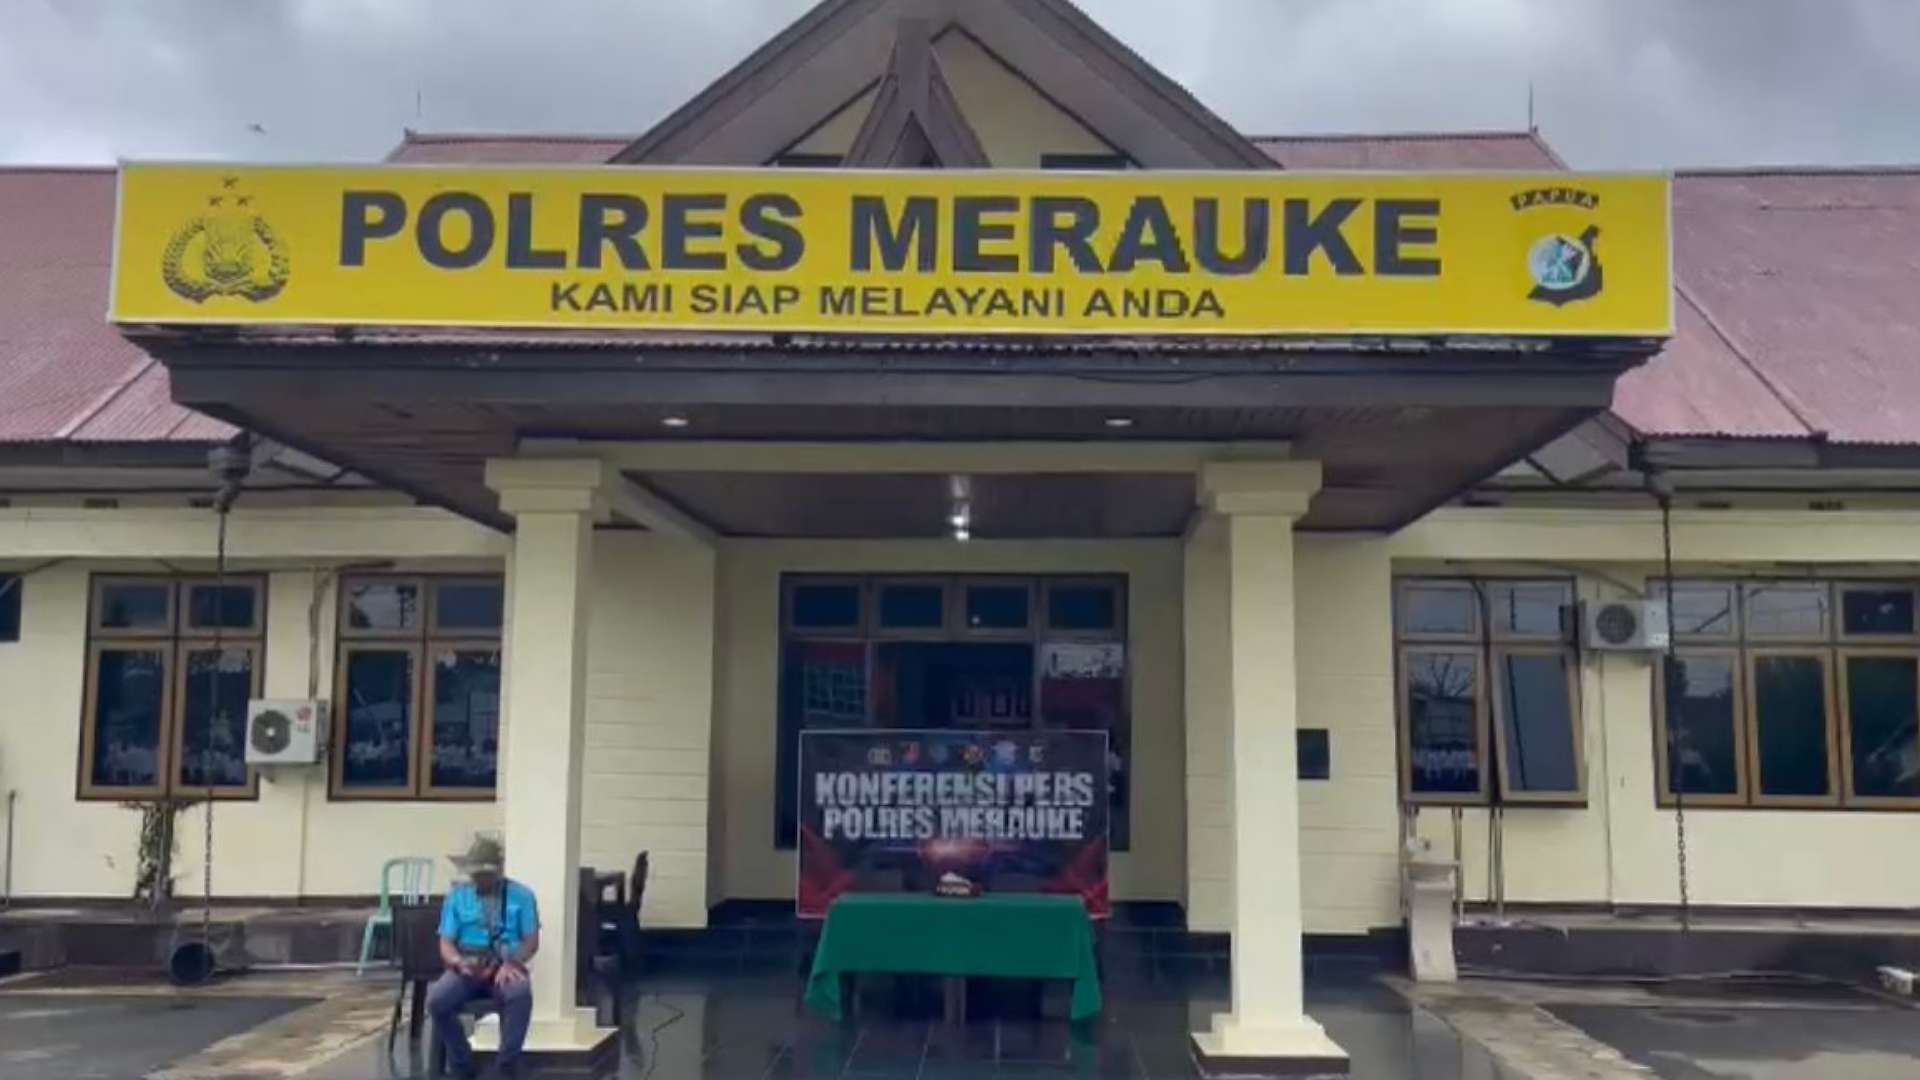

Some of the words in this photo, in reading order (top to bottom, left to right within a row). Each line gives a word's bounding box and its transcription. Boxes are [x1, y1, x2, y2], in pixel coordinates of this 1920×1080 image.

[1516, 188, 1594, 208] PAPUA
[340, 191, 805, 271] POLRES
[850, 196, 1441, 277] MERAUKE
[552, 283, 671, 313] KAMI
[690, 284, 799, 315] SIAP
[819, 286, 1065, 317] MELAYANI
[1083, 289, 1225, 319] ANDA
[816, 772, 1008, 806] KONFERENSI
[1014, 773, 1094, 806] PERS
[824, 807, 934, 839] POLRES
[941, 808, 1084, 839] MERAUKE
